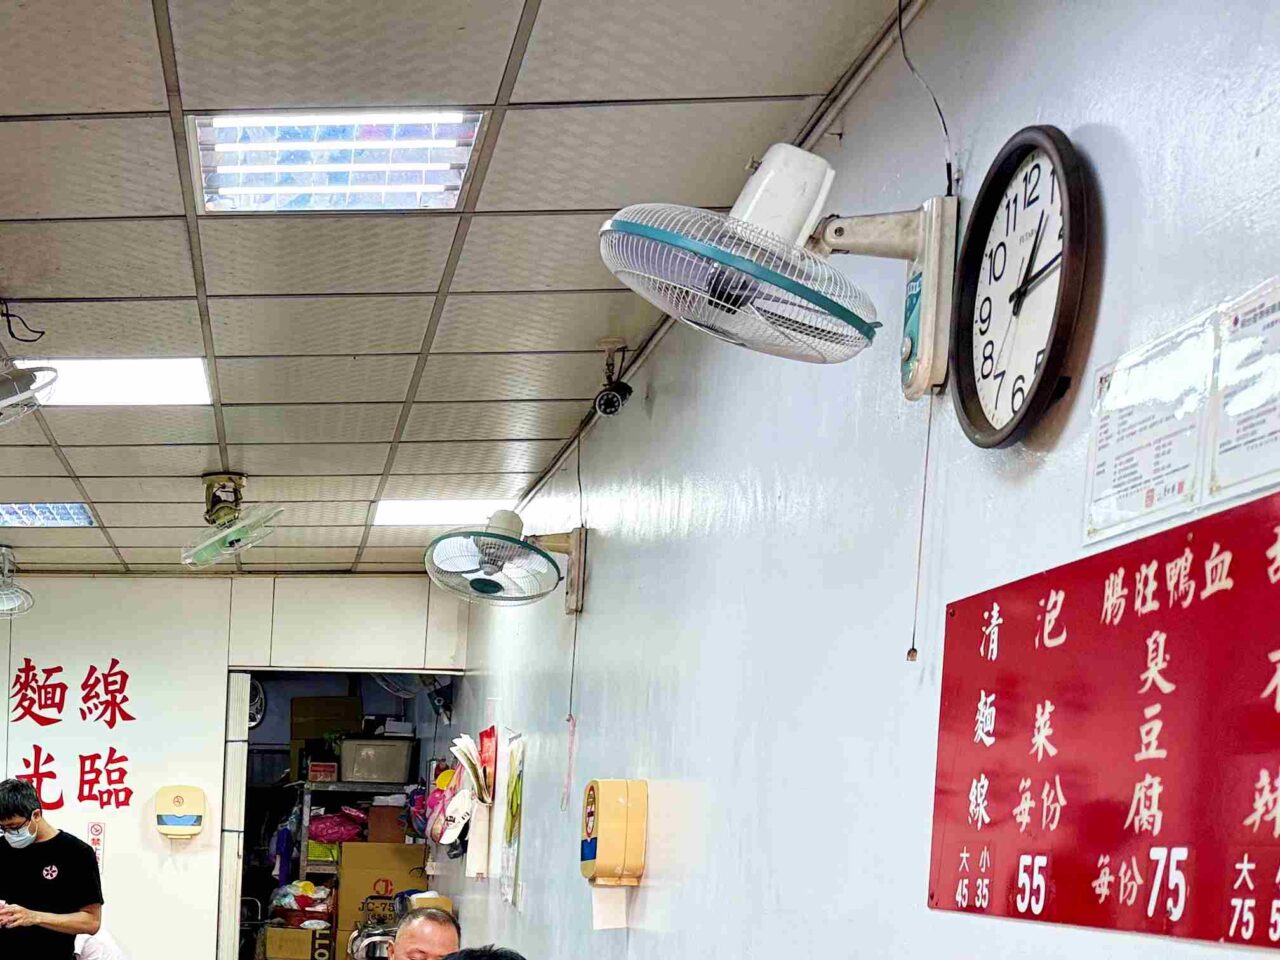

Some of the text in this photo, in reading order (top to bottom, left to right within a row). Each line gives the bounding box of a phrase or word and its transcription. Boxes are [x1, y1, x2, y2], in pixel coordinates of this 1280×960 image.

[1023, 163, 1041, 210] 12
[1005, 193, 1018, 237] 11
[989, 241, 1007, 285] 10
[979, 296, 992, 335] 9
[981, 340, 995, 380] 8
[993, 370, 1006, 410] 7
[1011, 374, 1025, 414] 6
[1100, 542, 1234, 626] 腸旺鴨血
[1030, 589, 1068, 763] 泡菜
[968, 602, 1004, 831] 清麵線
[1123, 630, 1177, 838] 臭豆腐
[1012, 774, 1068, 833] 每份
[959, 845, 991, 874] 大 小
[1233, 853, 1256, 891] 大
[955, 877, 990, 909] 45 35
[1016, 855, 1047, 915] 55
[1092, 847, 1189, 922] 每份 75
[1228, 898, 1257, 940] 75
